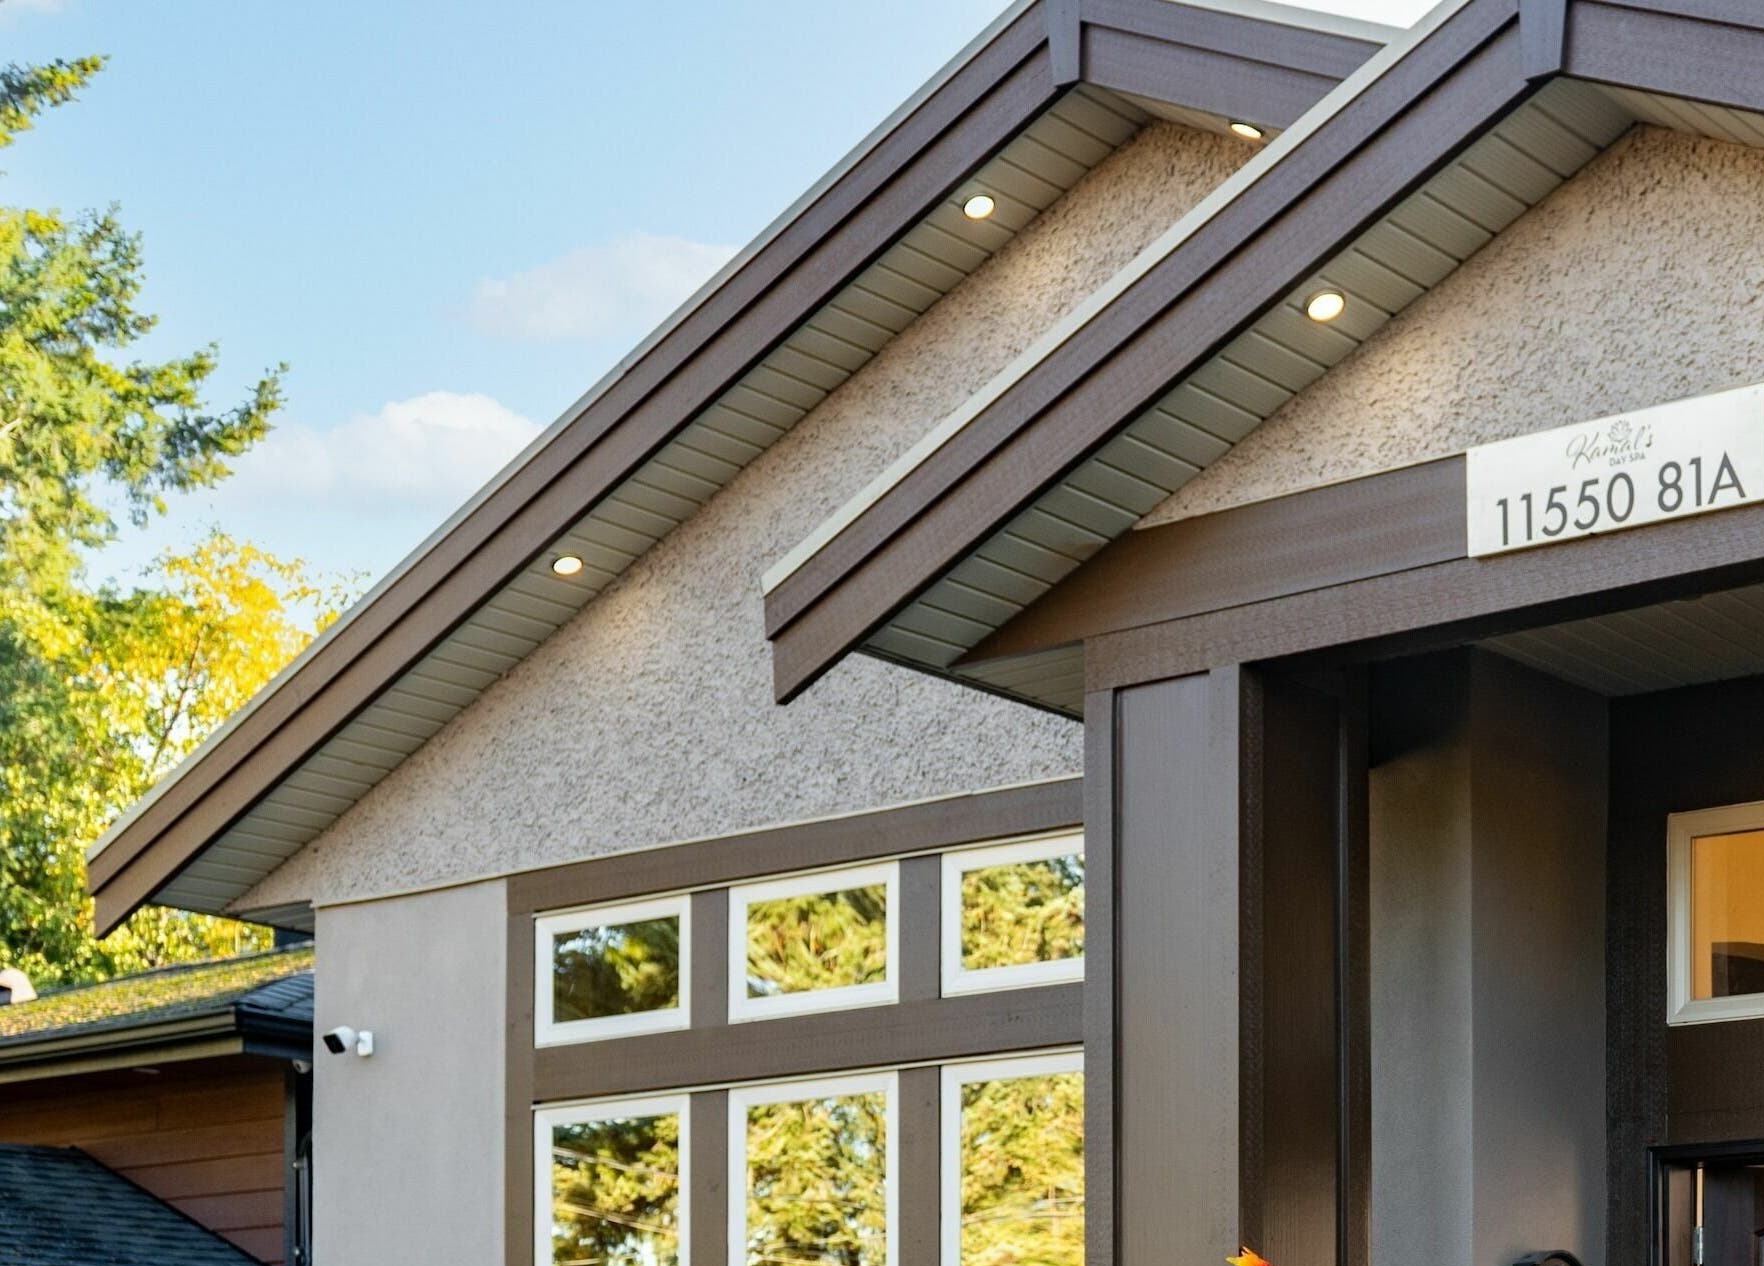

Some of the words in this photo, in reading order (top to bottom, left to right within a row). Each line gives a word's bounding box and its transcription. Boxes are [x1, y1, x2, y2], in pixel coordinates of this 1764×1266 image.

[1566, 424, 1653, 470] Kamal's
[1609, 454, 1626, 467] DAY
[1629, 452, 1647, 463] SPA
[1497, 472, 1635, 546] 11550
[1657, 451, 1746, 513] 81A
